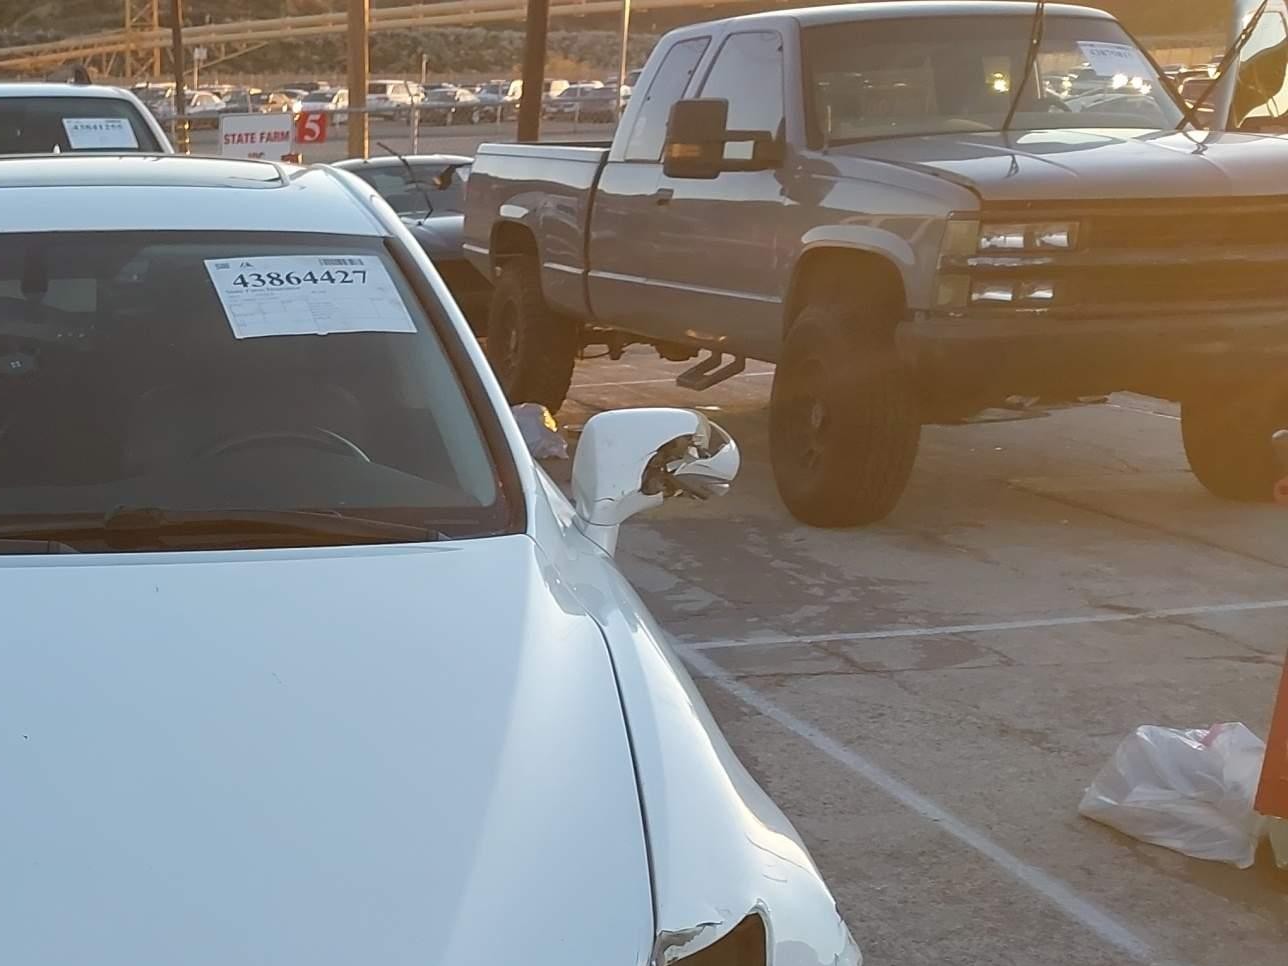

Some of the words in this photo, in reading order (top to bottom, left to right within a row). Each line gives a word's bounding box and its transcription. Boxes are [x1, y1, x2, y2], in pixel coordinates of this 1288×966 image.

[303, 113, 322, 141] 5
[223, 133, 257, 145] STATE
[259, 131, 291, 143] FARM
[232, 270, 367, 288] 43864427
